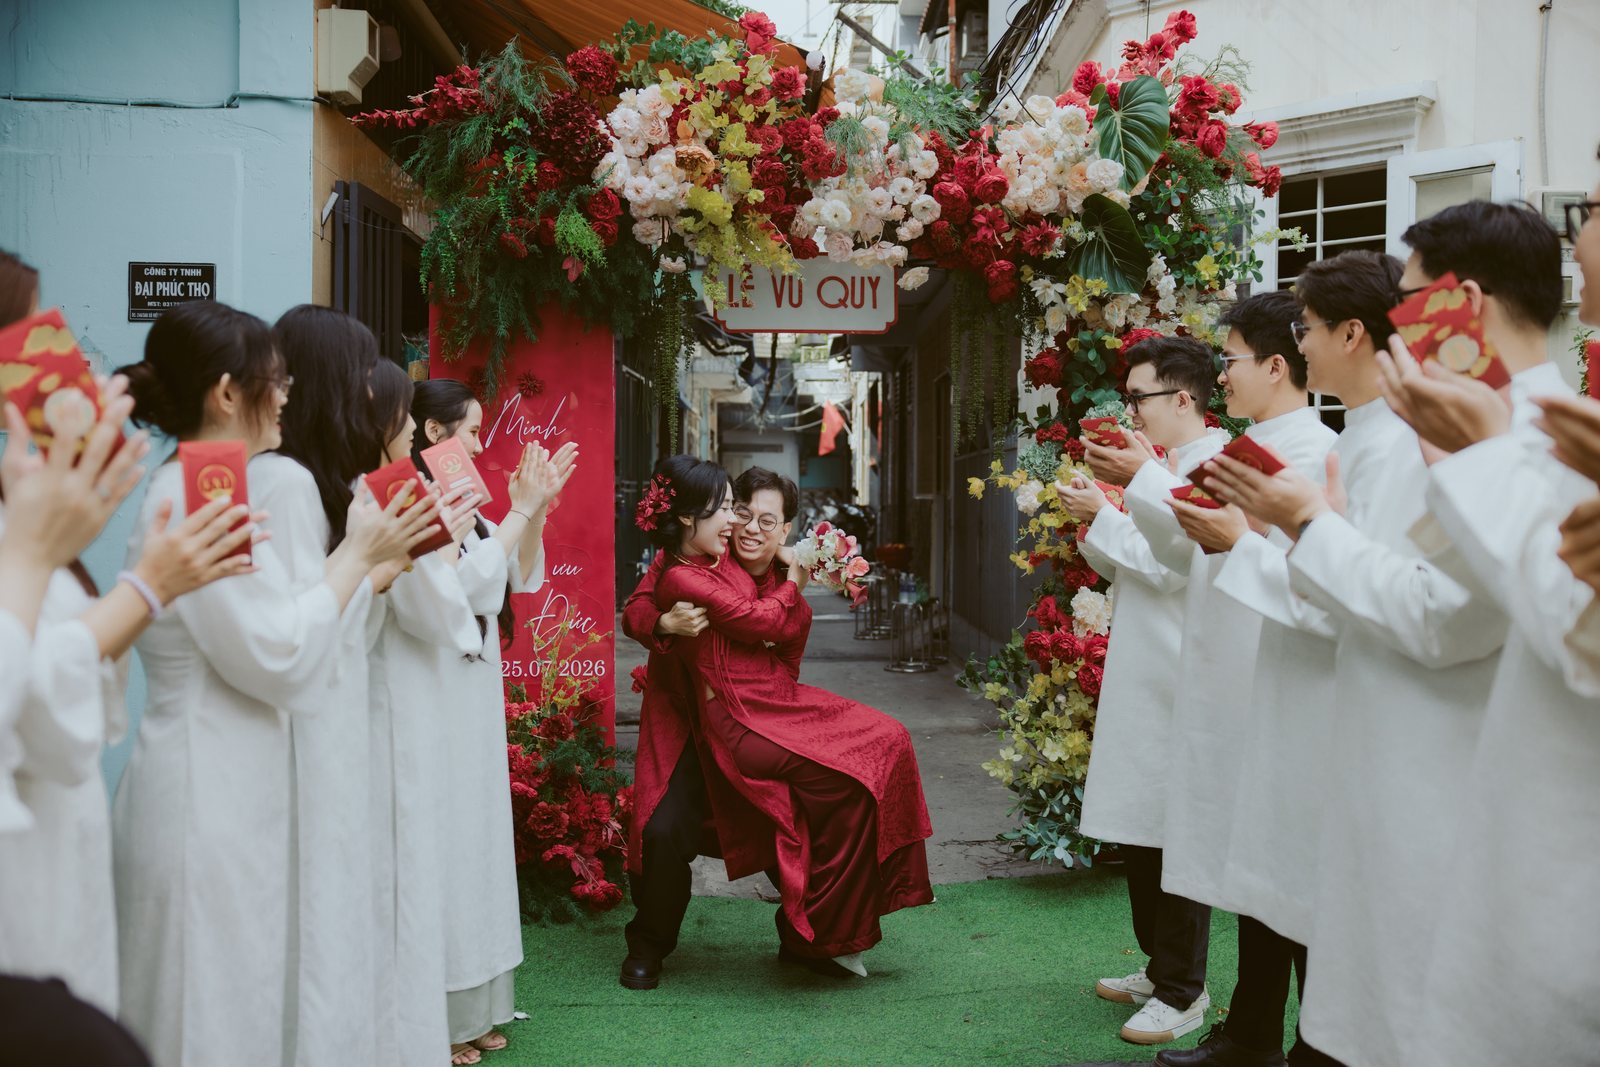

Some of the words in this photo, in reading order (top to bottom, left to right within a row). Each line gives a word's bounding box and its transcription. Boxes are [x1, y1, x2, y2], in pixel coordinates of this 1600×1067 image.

[135, 281, 153, 299] ĐẠI
[156, 278, 185, 297] PHÚC
[187, 282, 210, 300] THỌ
[144, 266, 167, 276] CÔNG
[169, 268, 178, 276] TY
[180, 268, 202, 277] TNHH
[771, 274, 804, 308] VU
[817, 275, 881, 309] QUY
[485, 392, 567, 448] Minh
[529, 588, 597, 651] Đức
